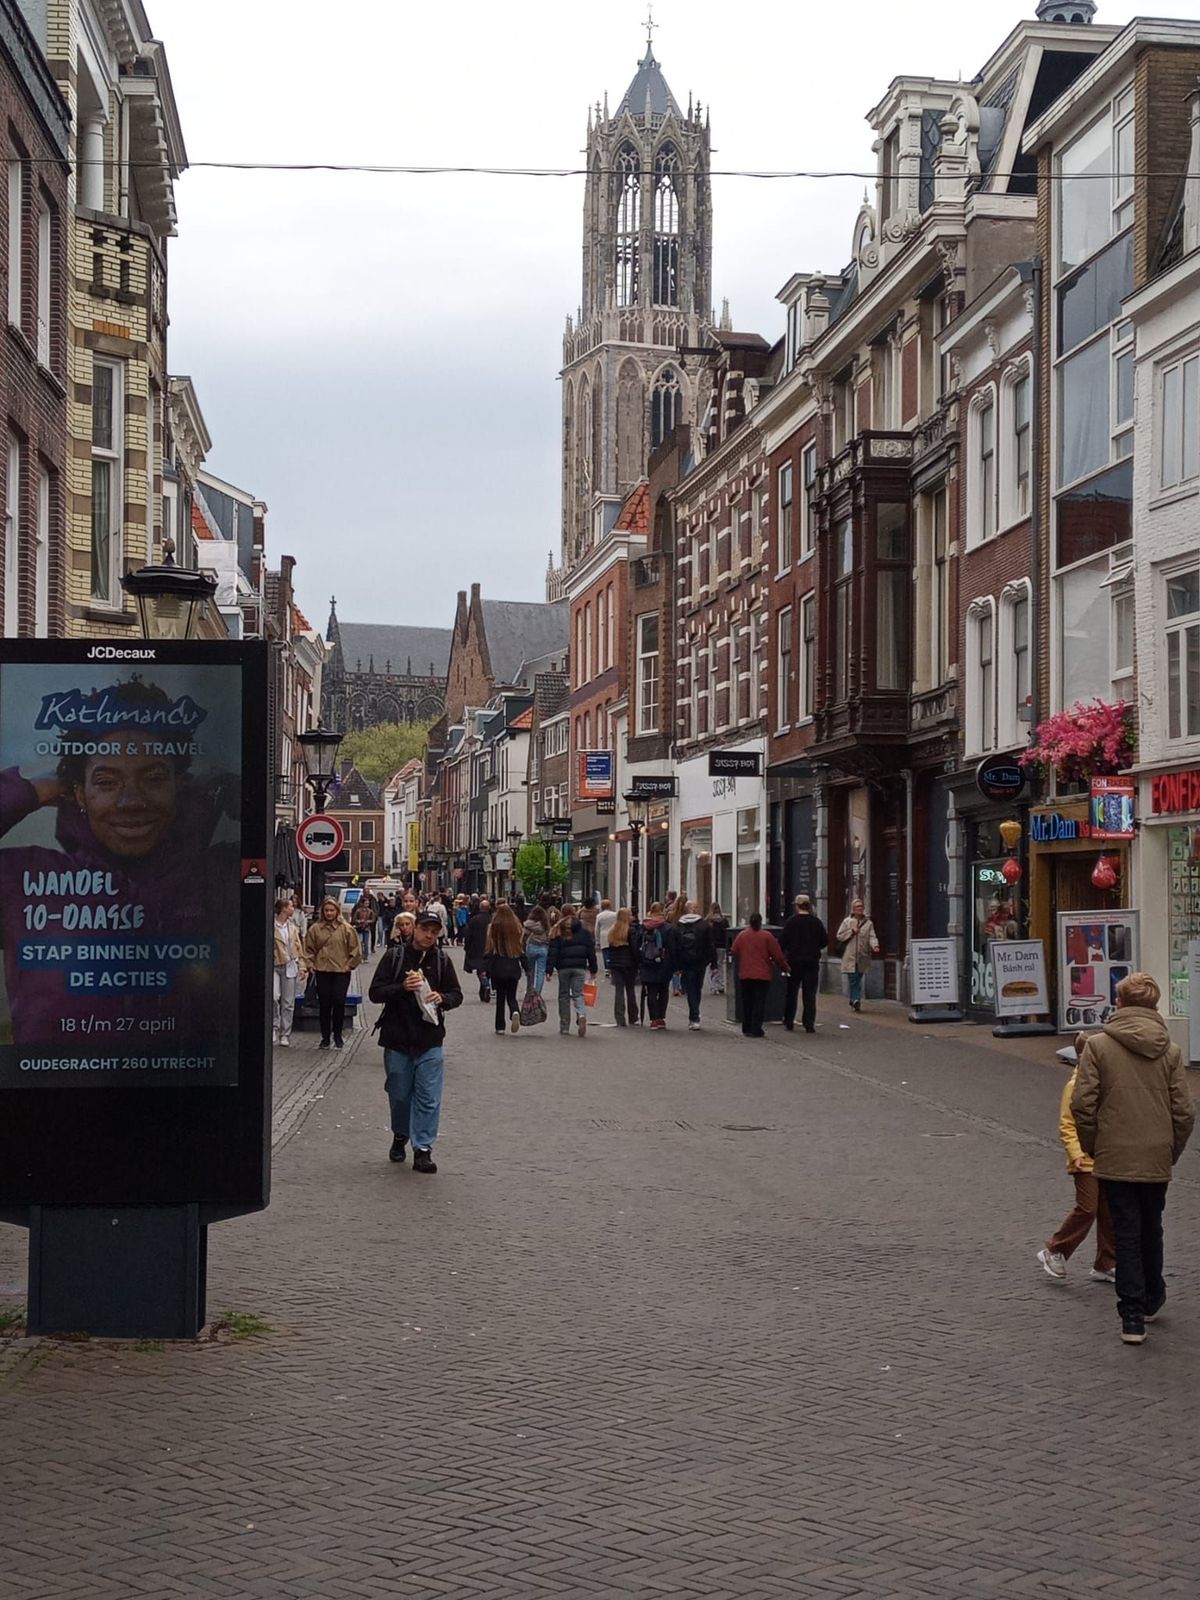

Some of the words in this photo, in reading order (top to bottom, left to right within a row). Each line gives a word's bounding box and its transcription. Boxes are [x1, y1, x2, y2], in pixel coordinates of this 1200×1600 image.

[87, 646, 156, 659] JCDecaux
[42, 695, 201, 726] Kathmandu
[36, 742, 120, 756] OUTDOOR
[127, 742, 138, 756] &
[143, 742, 205, 756] TRAVEL
[1031, 814, 1049, 841] Mr.
[1049, 812, 1076, 840] Dam
[23, 869, 120, 897] WANDEL
[23, 904, 145, 930] 10-DAAGSE
[22, 945, 72, 960] STAP
[77, 945, 149, 960] BINNEN
[152, 945, 211, 960] VOOR
[1015, 951, 1039, 961] Dam
[70, 972, 94, 987] DE
[99, 971, 168, 986] ACTIES
[61, 1018, 76, 1032] 18
[81, 1014, 111, 1034] t/m
[116, 1018, 135, 1031] 27
[139, 1017, 175, 1034] april
[20, 1058, 119, 1070] OUDEGRACHT
[122, 1058, 148, 1069] 260
[152, 1057, 216, 1069] UTRECHT
